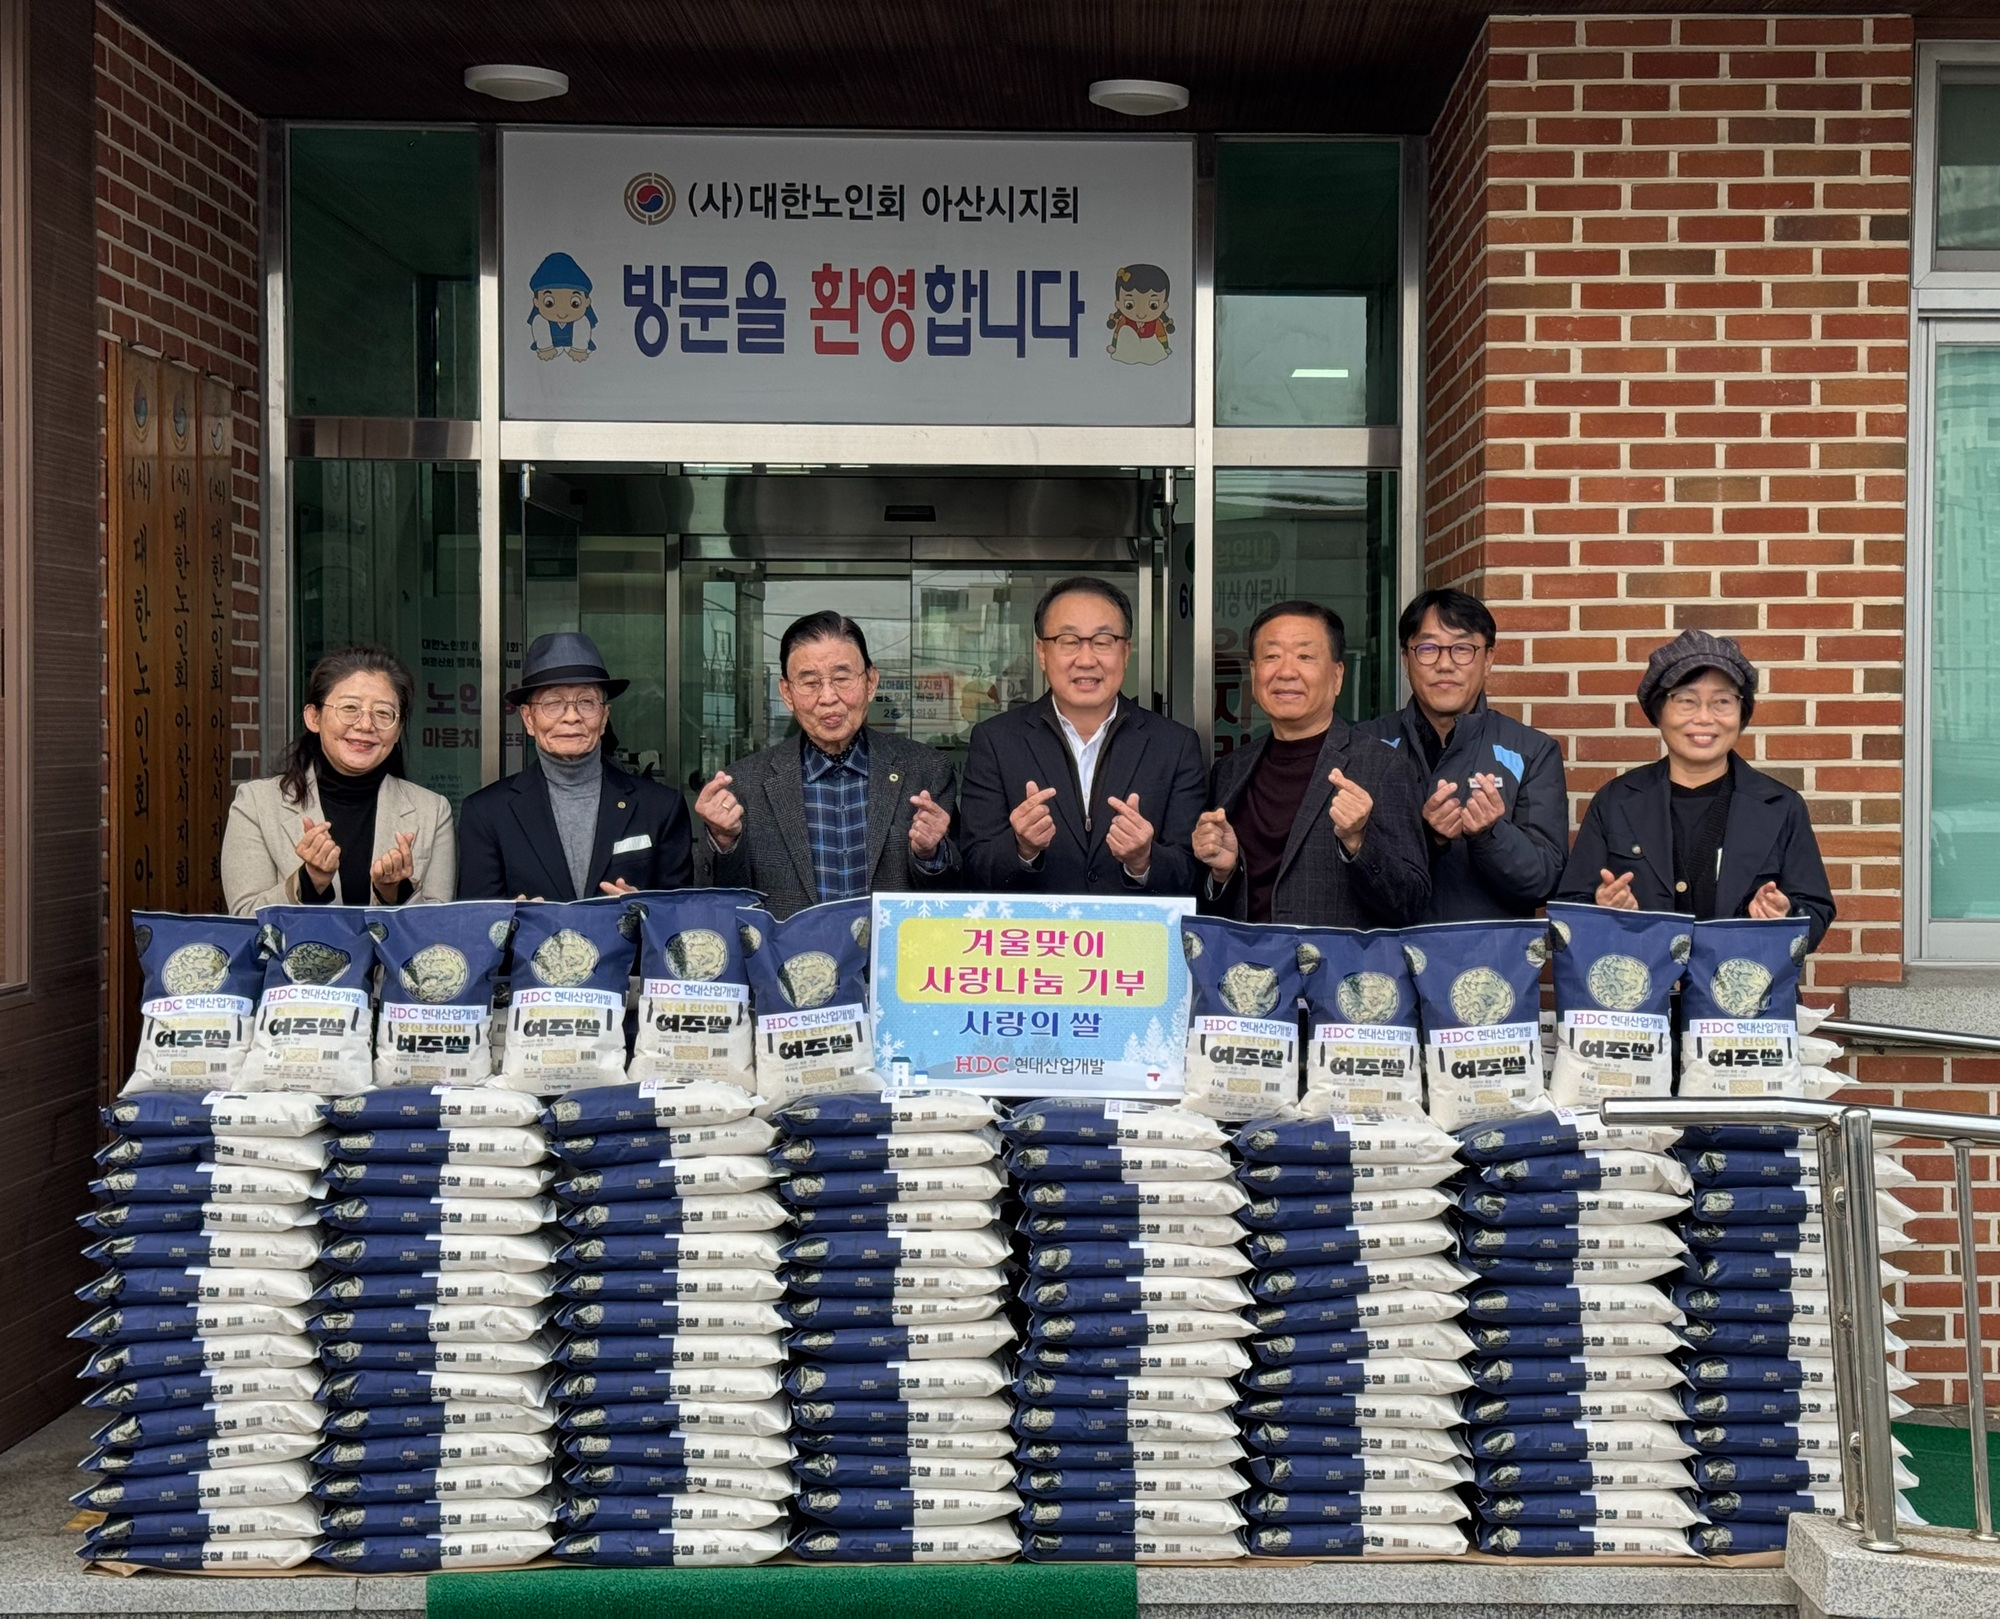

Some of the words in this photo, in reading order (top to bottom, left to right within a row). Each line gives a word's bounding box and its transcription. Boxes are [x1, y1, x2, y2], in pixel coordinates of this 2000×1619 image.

[688, 181, 905, 224] (사)대한노인회
[922, 184, 1080, 225] 아산시지회
[623, 260, 787, 358] 방문을
[809, 262, 1085, 363] 환영합니다
[175, 705, 191, 888] 아산시지회
[961, 928, 1105, 959] 겨울맞이
[650, 982, 681, 995] HDC
[684, 984, 741, 998] 현대산업개발
[918, 966, 1064, 996] 사랑나눔
[1076, 968, 1146, 997] 기부
[150, 999, 183, 1013] HDC
[186, 998, 245, 1011] 현대산업개발
[268, 988, 298, 1002] HDC
[301, 988, 362, 1004] 현대산업개발
[519, 991, 551, 1004] HDC
[554, 991, 612, 1006] 현대산업개발
[389, 1006, 418, 1019] HDC
[421, 1008, 480, 1020] 현대산업개발
[765, 1016, 799, 1030] HDC
[801, 1008, 856, 1026] 현대산업개발
[1573, 1013, 1608, 1025] HDC
[1611, 1015, 1664, 1029] 현대산업개발
[268, 1017, 346, 1037] 여주쌀
[523, 1018, 601, 1037] 여주쌀
[656, 1014, 732, 1034] 여주쌀
[959, 1010, 1059, 1038] 사랑의
[1069, 1011, 1104, 1038] 쌀
[1203, 1019, 1237, 1031] HDC
[1240, 1021, 1292, 1037] 현대산업개발
[1322, 1027, 1355, 1039] HDC
[1358, 1028, 1412, 1041] 현대산업개발
[1699, 1022, 1734, 1034] HDC
[1737, 1022, 1789, 1034] 현대산업개발
[155, 1029, 231, 1048] 여주쌀
[396, 1034, 471, 1054] 여주쌀
[1439, 1030, 1474, 1044] HDC
[1477, 1026, 1532, 1040] 현대산업개발
[778, 1033, 853, 1060] 여주쌀
[1579, 1039, 1655, 1062] 여주쌀
[954, 1055, 1010, 1074] HDC
[1014, 1056, 1106, 1076] 현대산업개발
[1209, 1045, 1284, 1069] 여주쌀
[1708, 1048, 1784, 1067] 여주쌀
[1329, 1057, 1405, 1078] 여주쌀
[1451, 1055, 1526, 1080] 여주쌀
